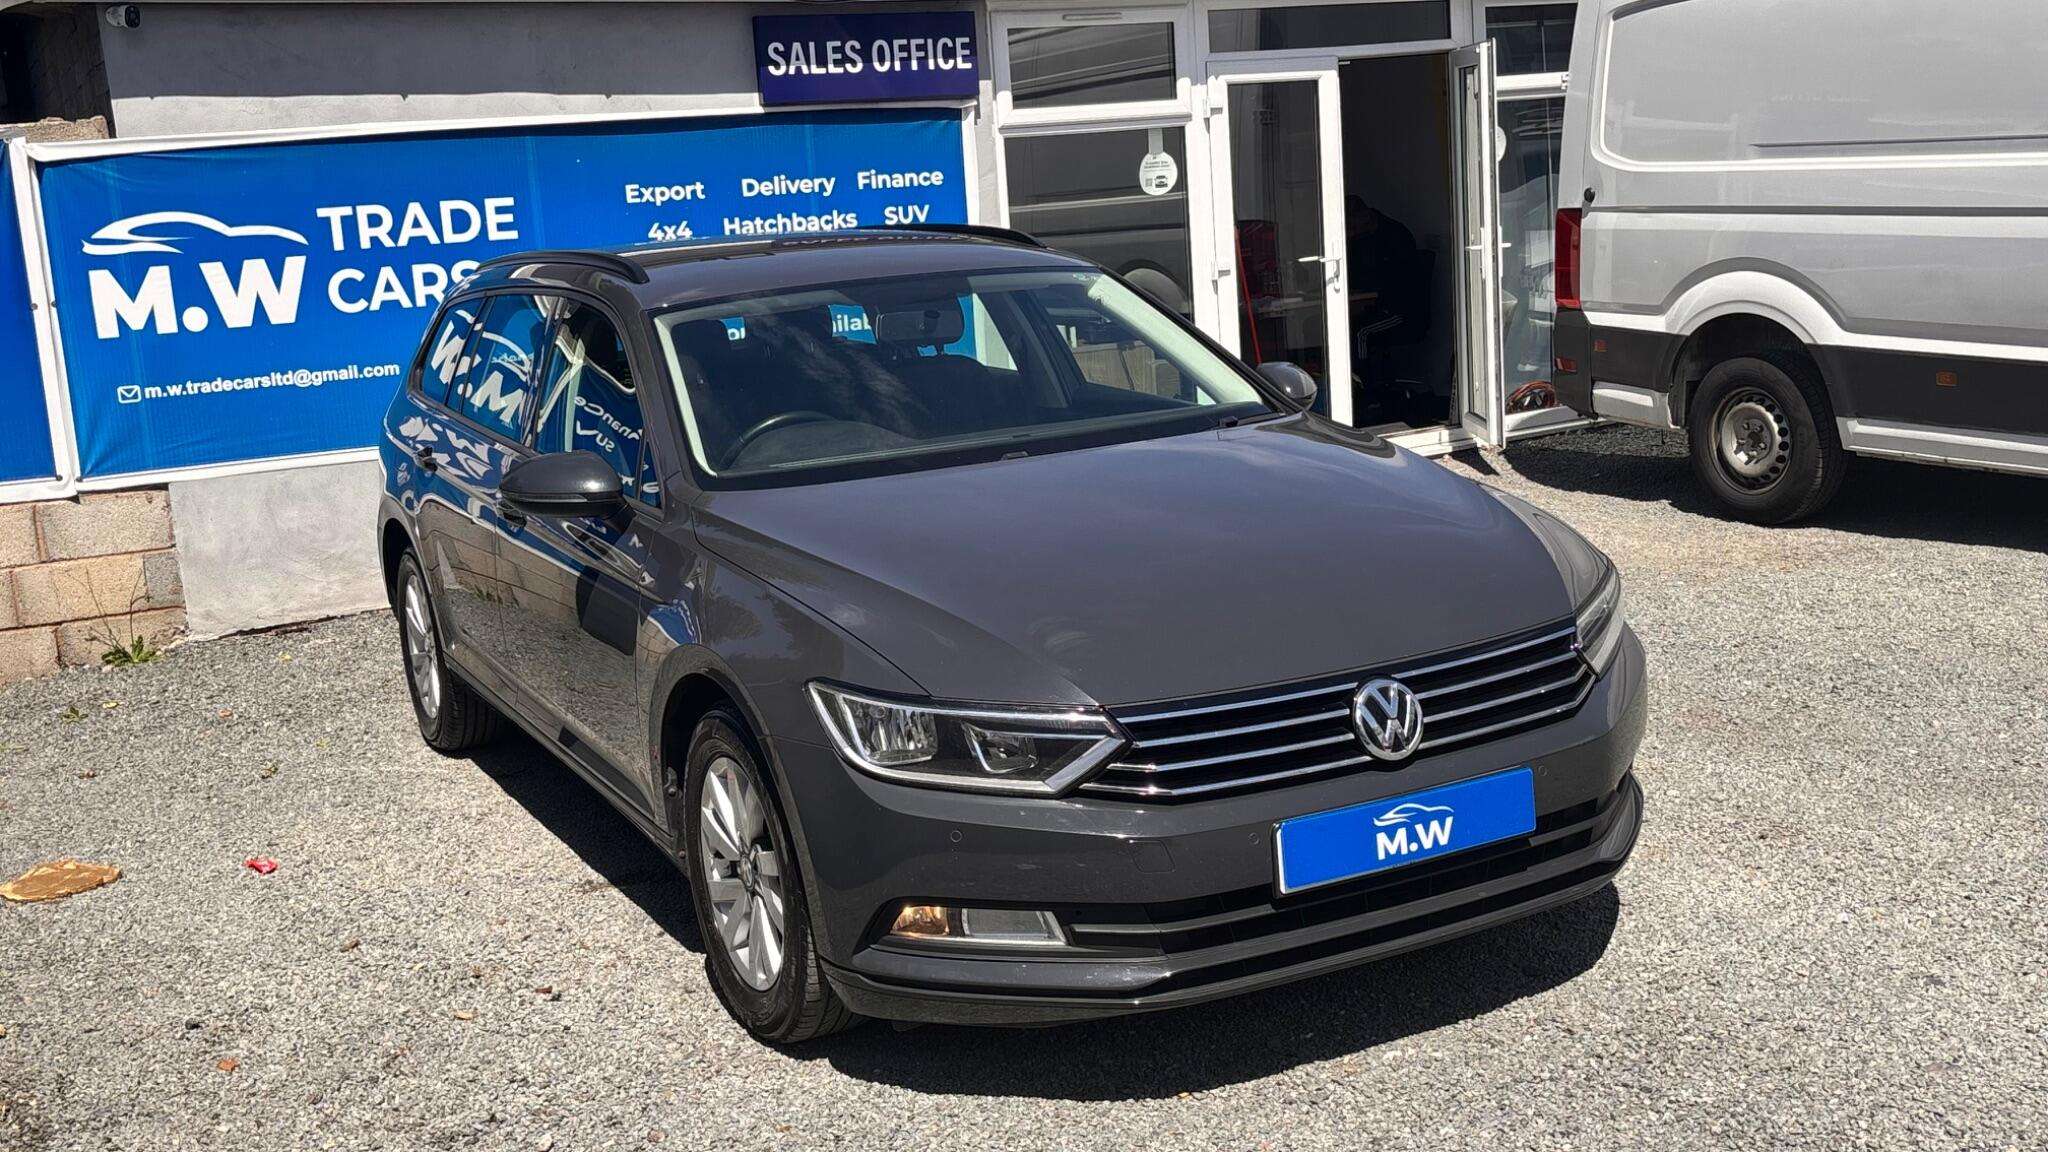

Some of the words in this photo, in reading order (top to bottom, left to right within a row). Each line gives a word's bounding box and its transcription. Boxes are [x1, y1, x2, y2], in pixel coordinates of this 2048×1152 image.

[767, 41, 864, 77] SALES
[871, 37, 973, 72] OFFICE
[741, 175, 836, 197] Delivery
[857, 169, 944, 190] Finance
[625, 181, 706, 206] Export
[317, 197, 519, 251] TRADE
[723, 209, 859, 236] Hatchbacks
[884, 205, 930, 226] SUV
[648, 221, 693, 241] 4x4
[89, 255, 307, 339] M.W
[144, 363, 400, 399] m.w.tradecarsltd@gmail.com
[1376, 816, 1454, 860] M.W
